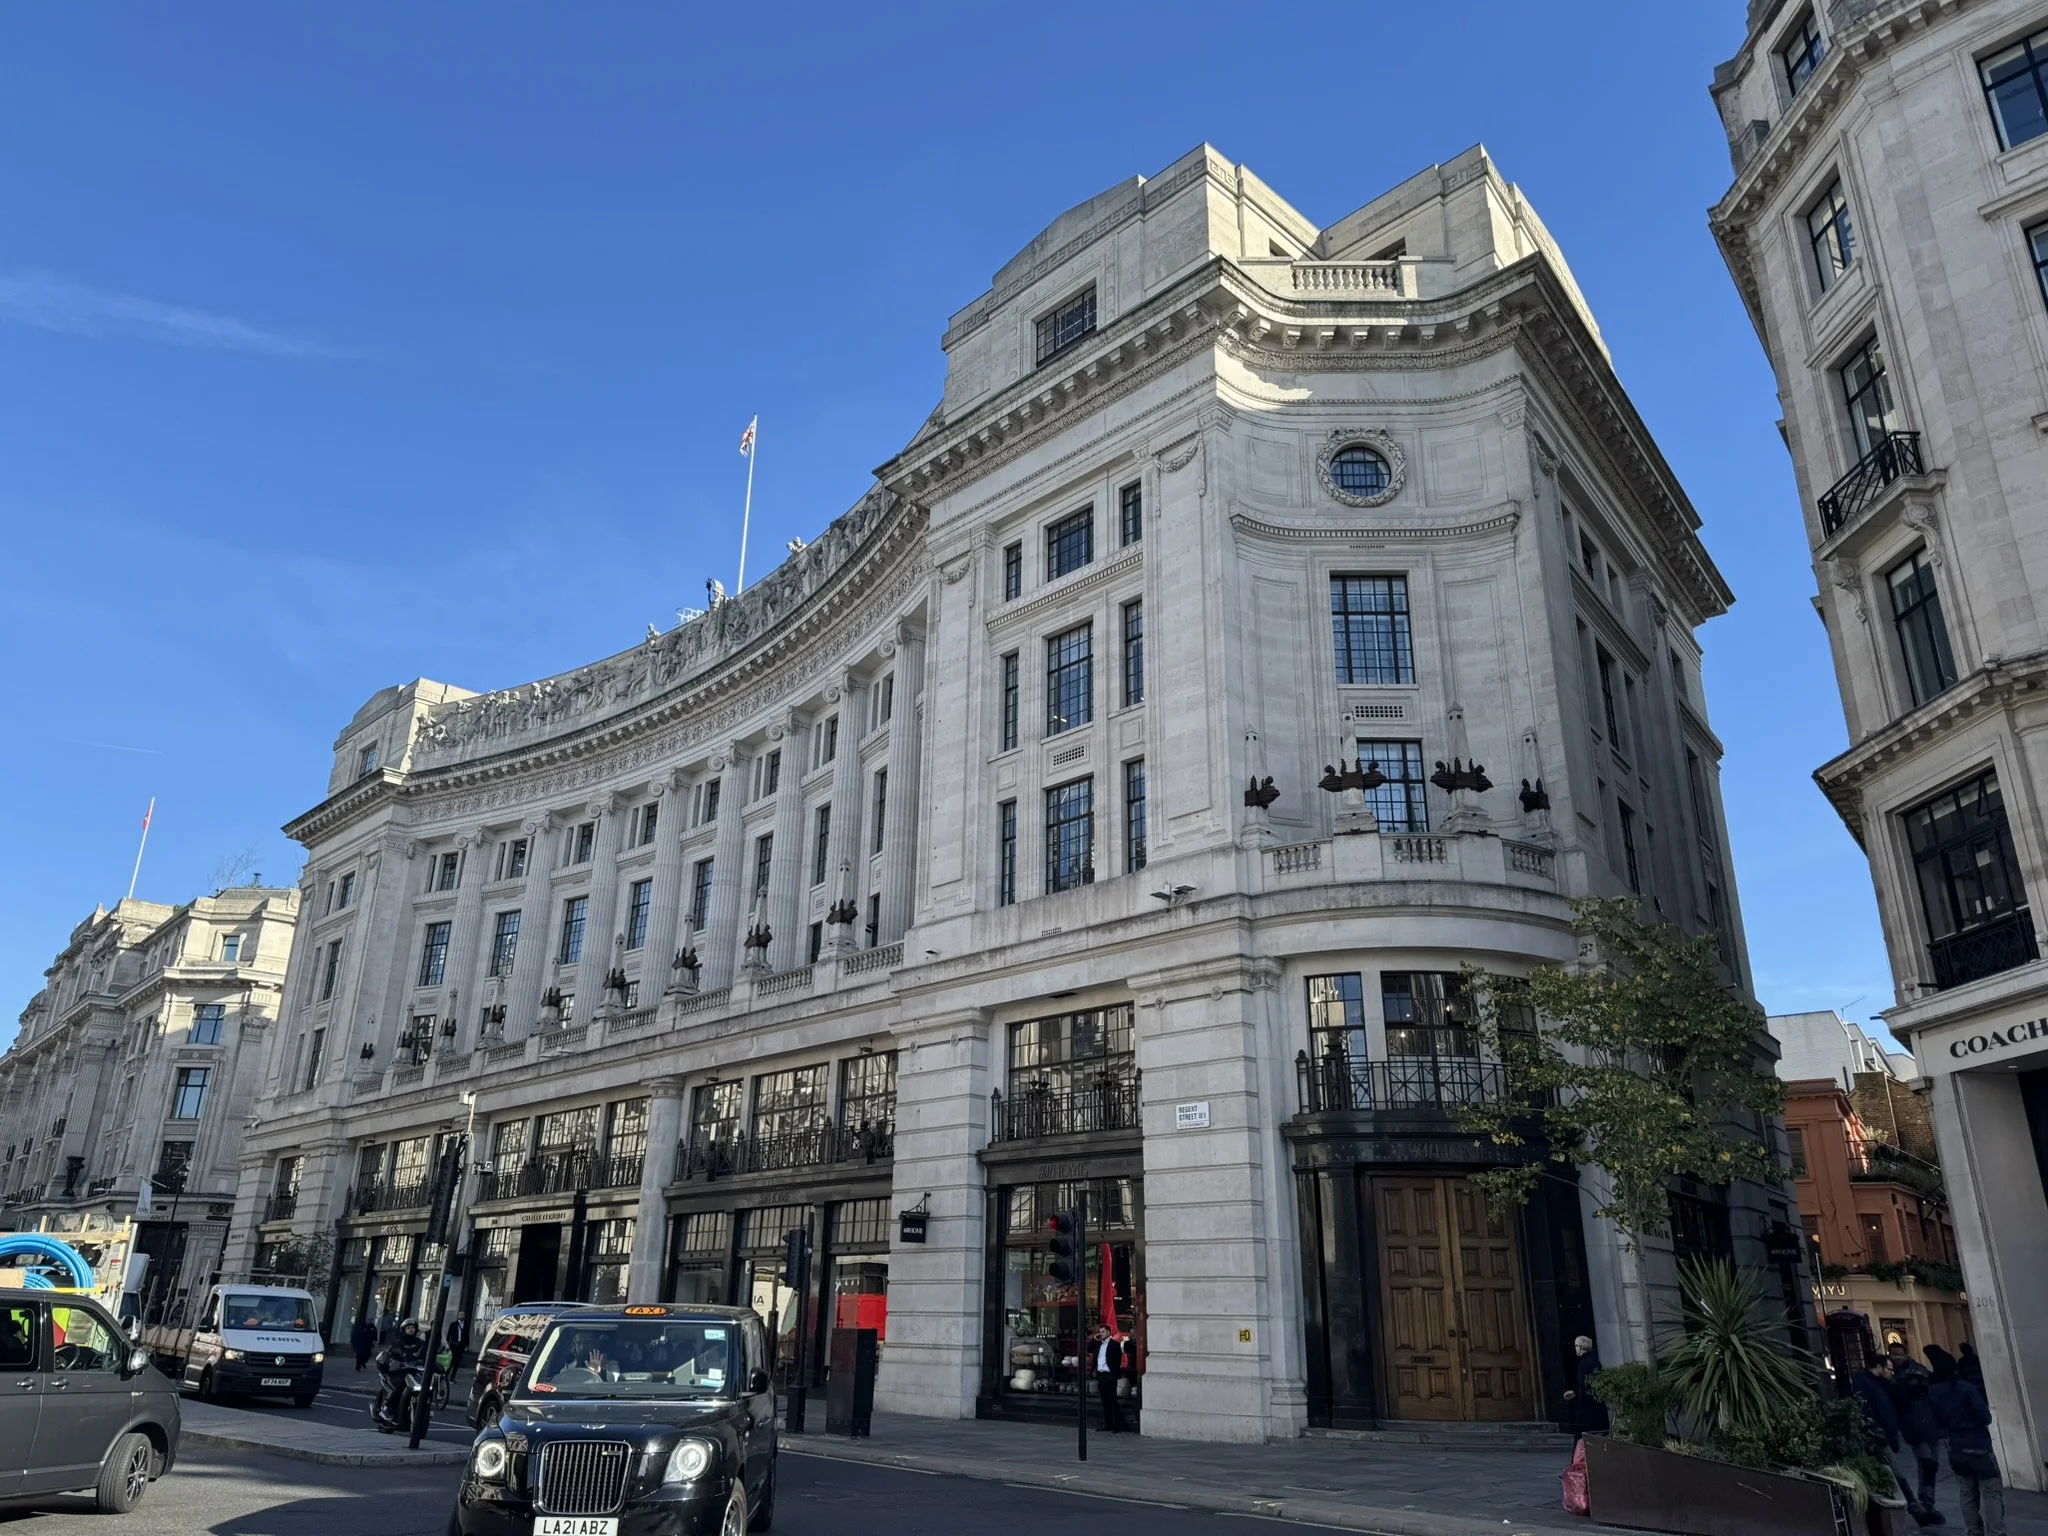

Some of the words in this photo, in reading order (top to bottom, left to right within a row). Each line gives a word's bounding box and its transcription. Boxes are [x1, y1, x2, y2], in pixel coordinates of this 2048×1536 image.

[1950, 1018, 2048, 1058] COACH
[1178, 1105, 1198, 1114] REGENT
[1178, 1112, 1197, 1121] STREET
[1976, 1296, 1995, 1308] 206
[543, 1520, 576, 1535] LA21
[579, 1520, 609, 1535] ABZ
